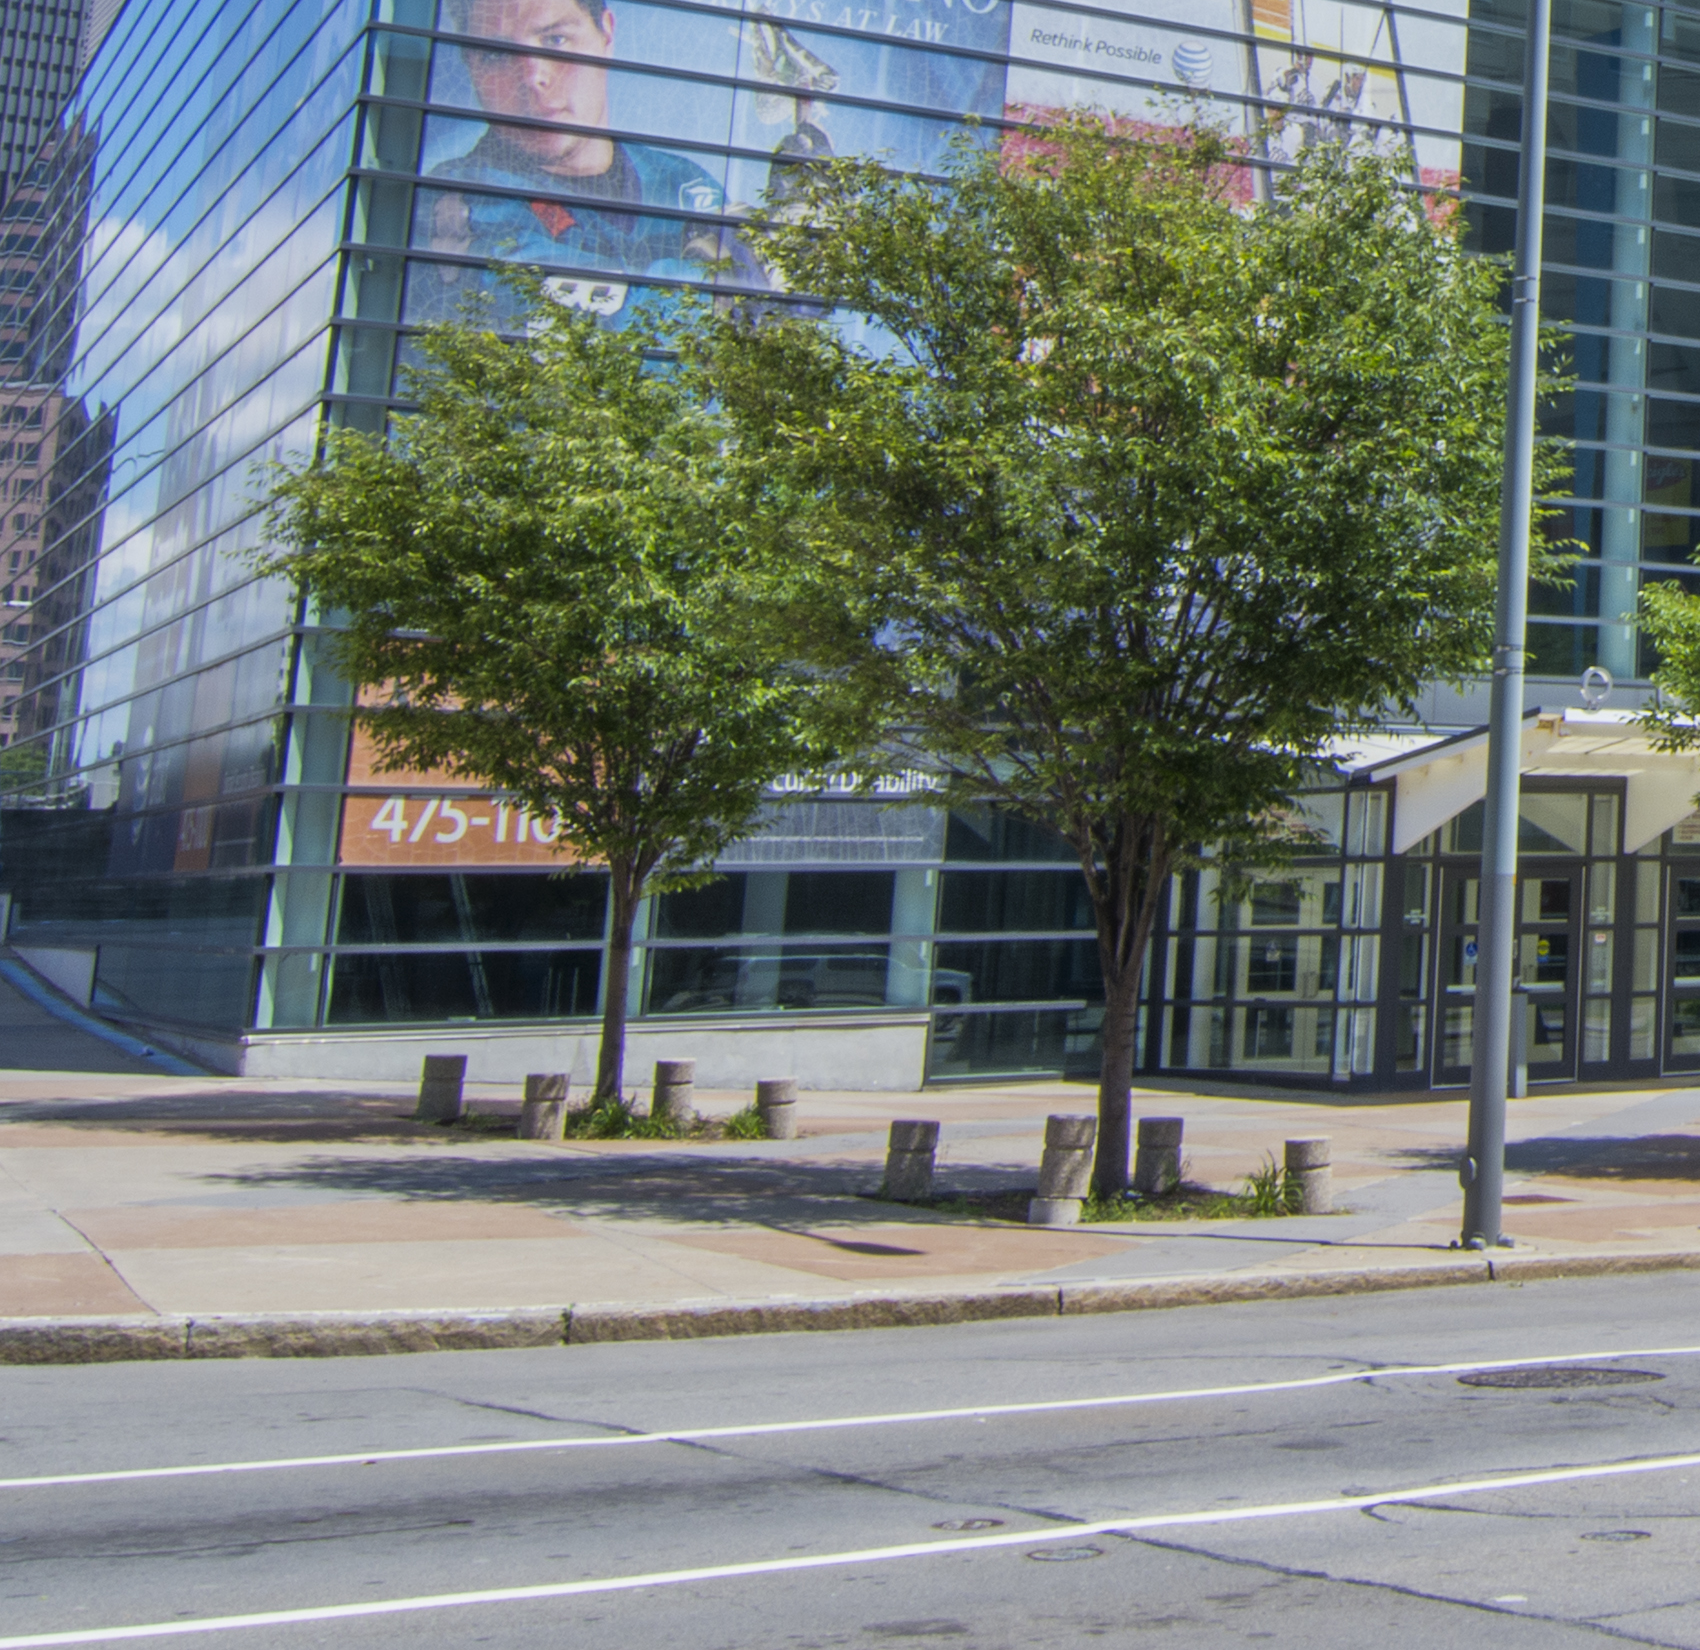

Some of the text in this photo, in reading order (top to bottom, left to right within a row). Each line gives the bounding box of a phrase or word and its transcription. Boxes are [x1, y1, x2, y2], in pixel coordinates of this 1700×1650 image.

[833, 7, 878, 31] AT
[884, 14, 949, 44] LAW
[1030, 28, 1163, 65] Rethink Possible
